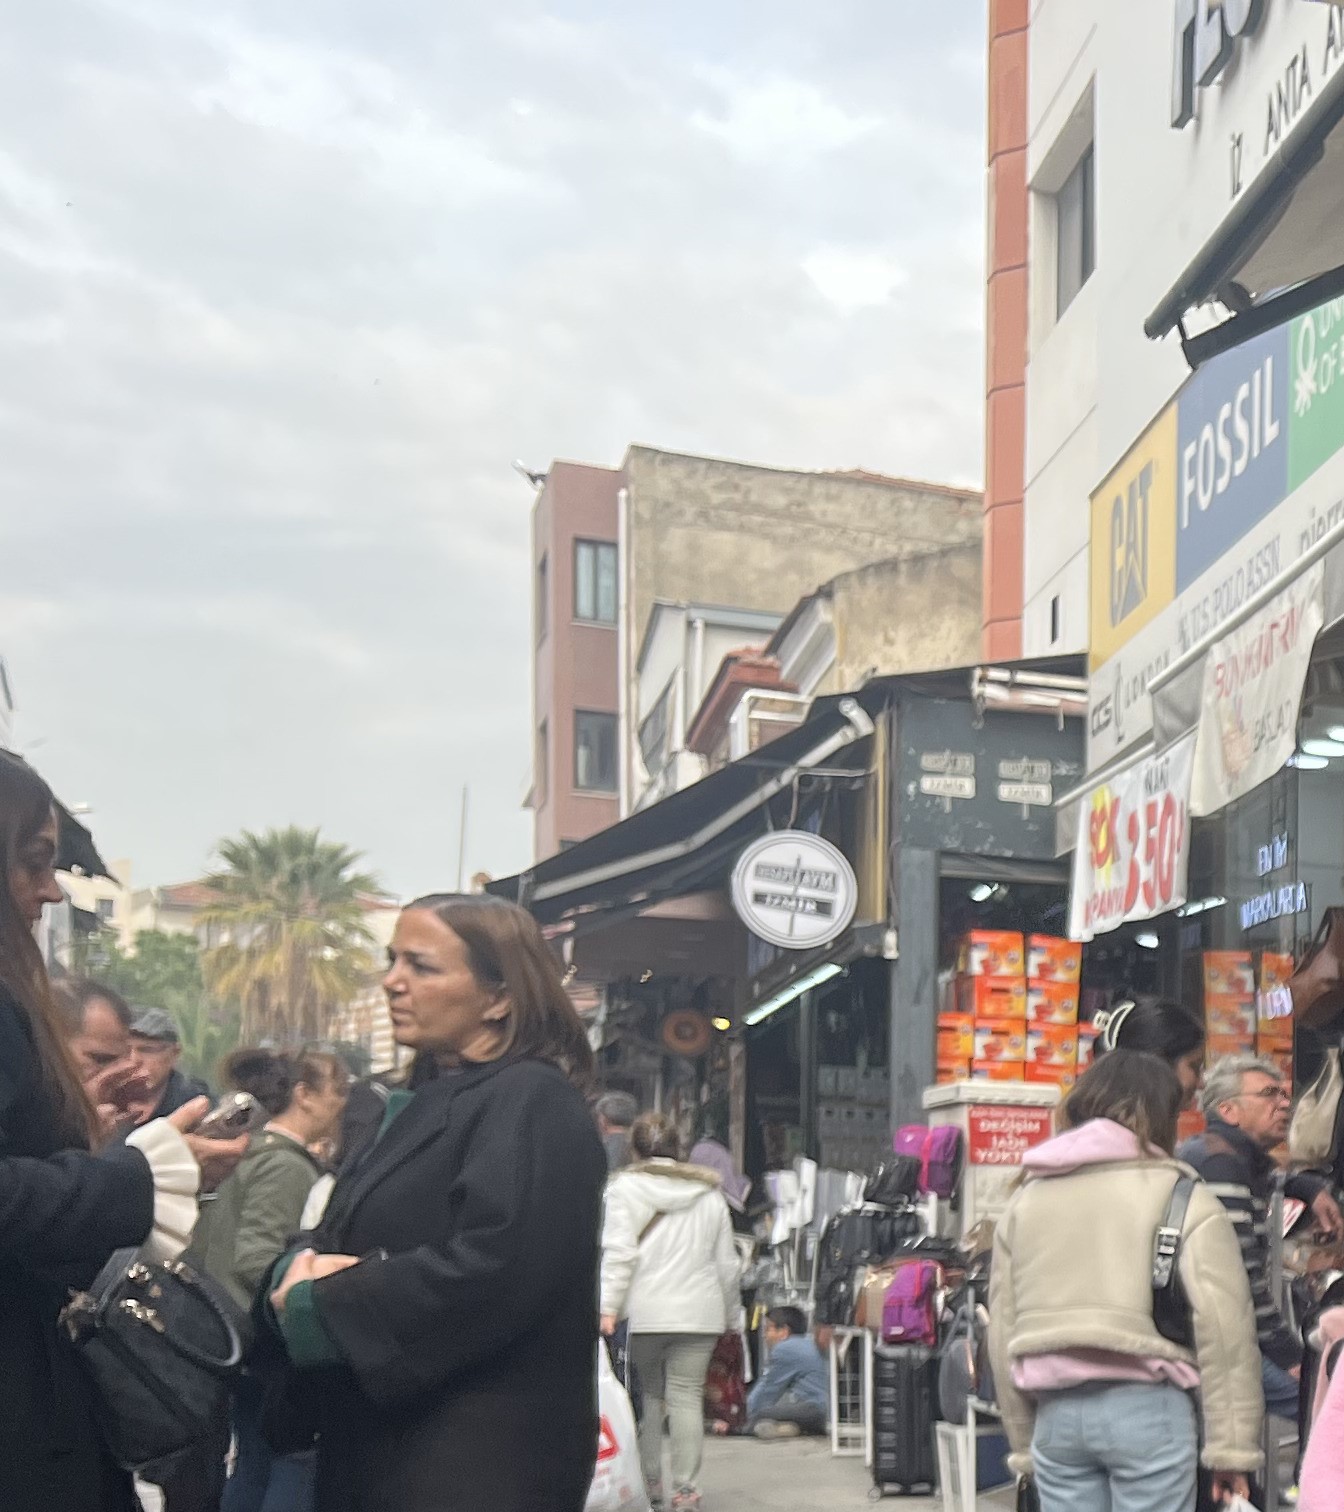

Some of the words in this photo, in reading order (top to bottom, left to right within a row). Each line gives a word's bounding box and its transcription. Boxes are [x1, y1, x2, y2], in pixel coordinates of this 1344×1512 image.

[1320, 342, 1339, 394] OF
[1181, 355, 1280, 529] FOSSIL
[1110, 458, 1153, 629] CAT
[1124, 792, 1176, 915] 350
